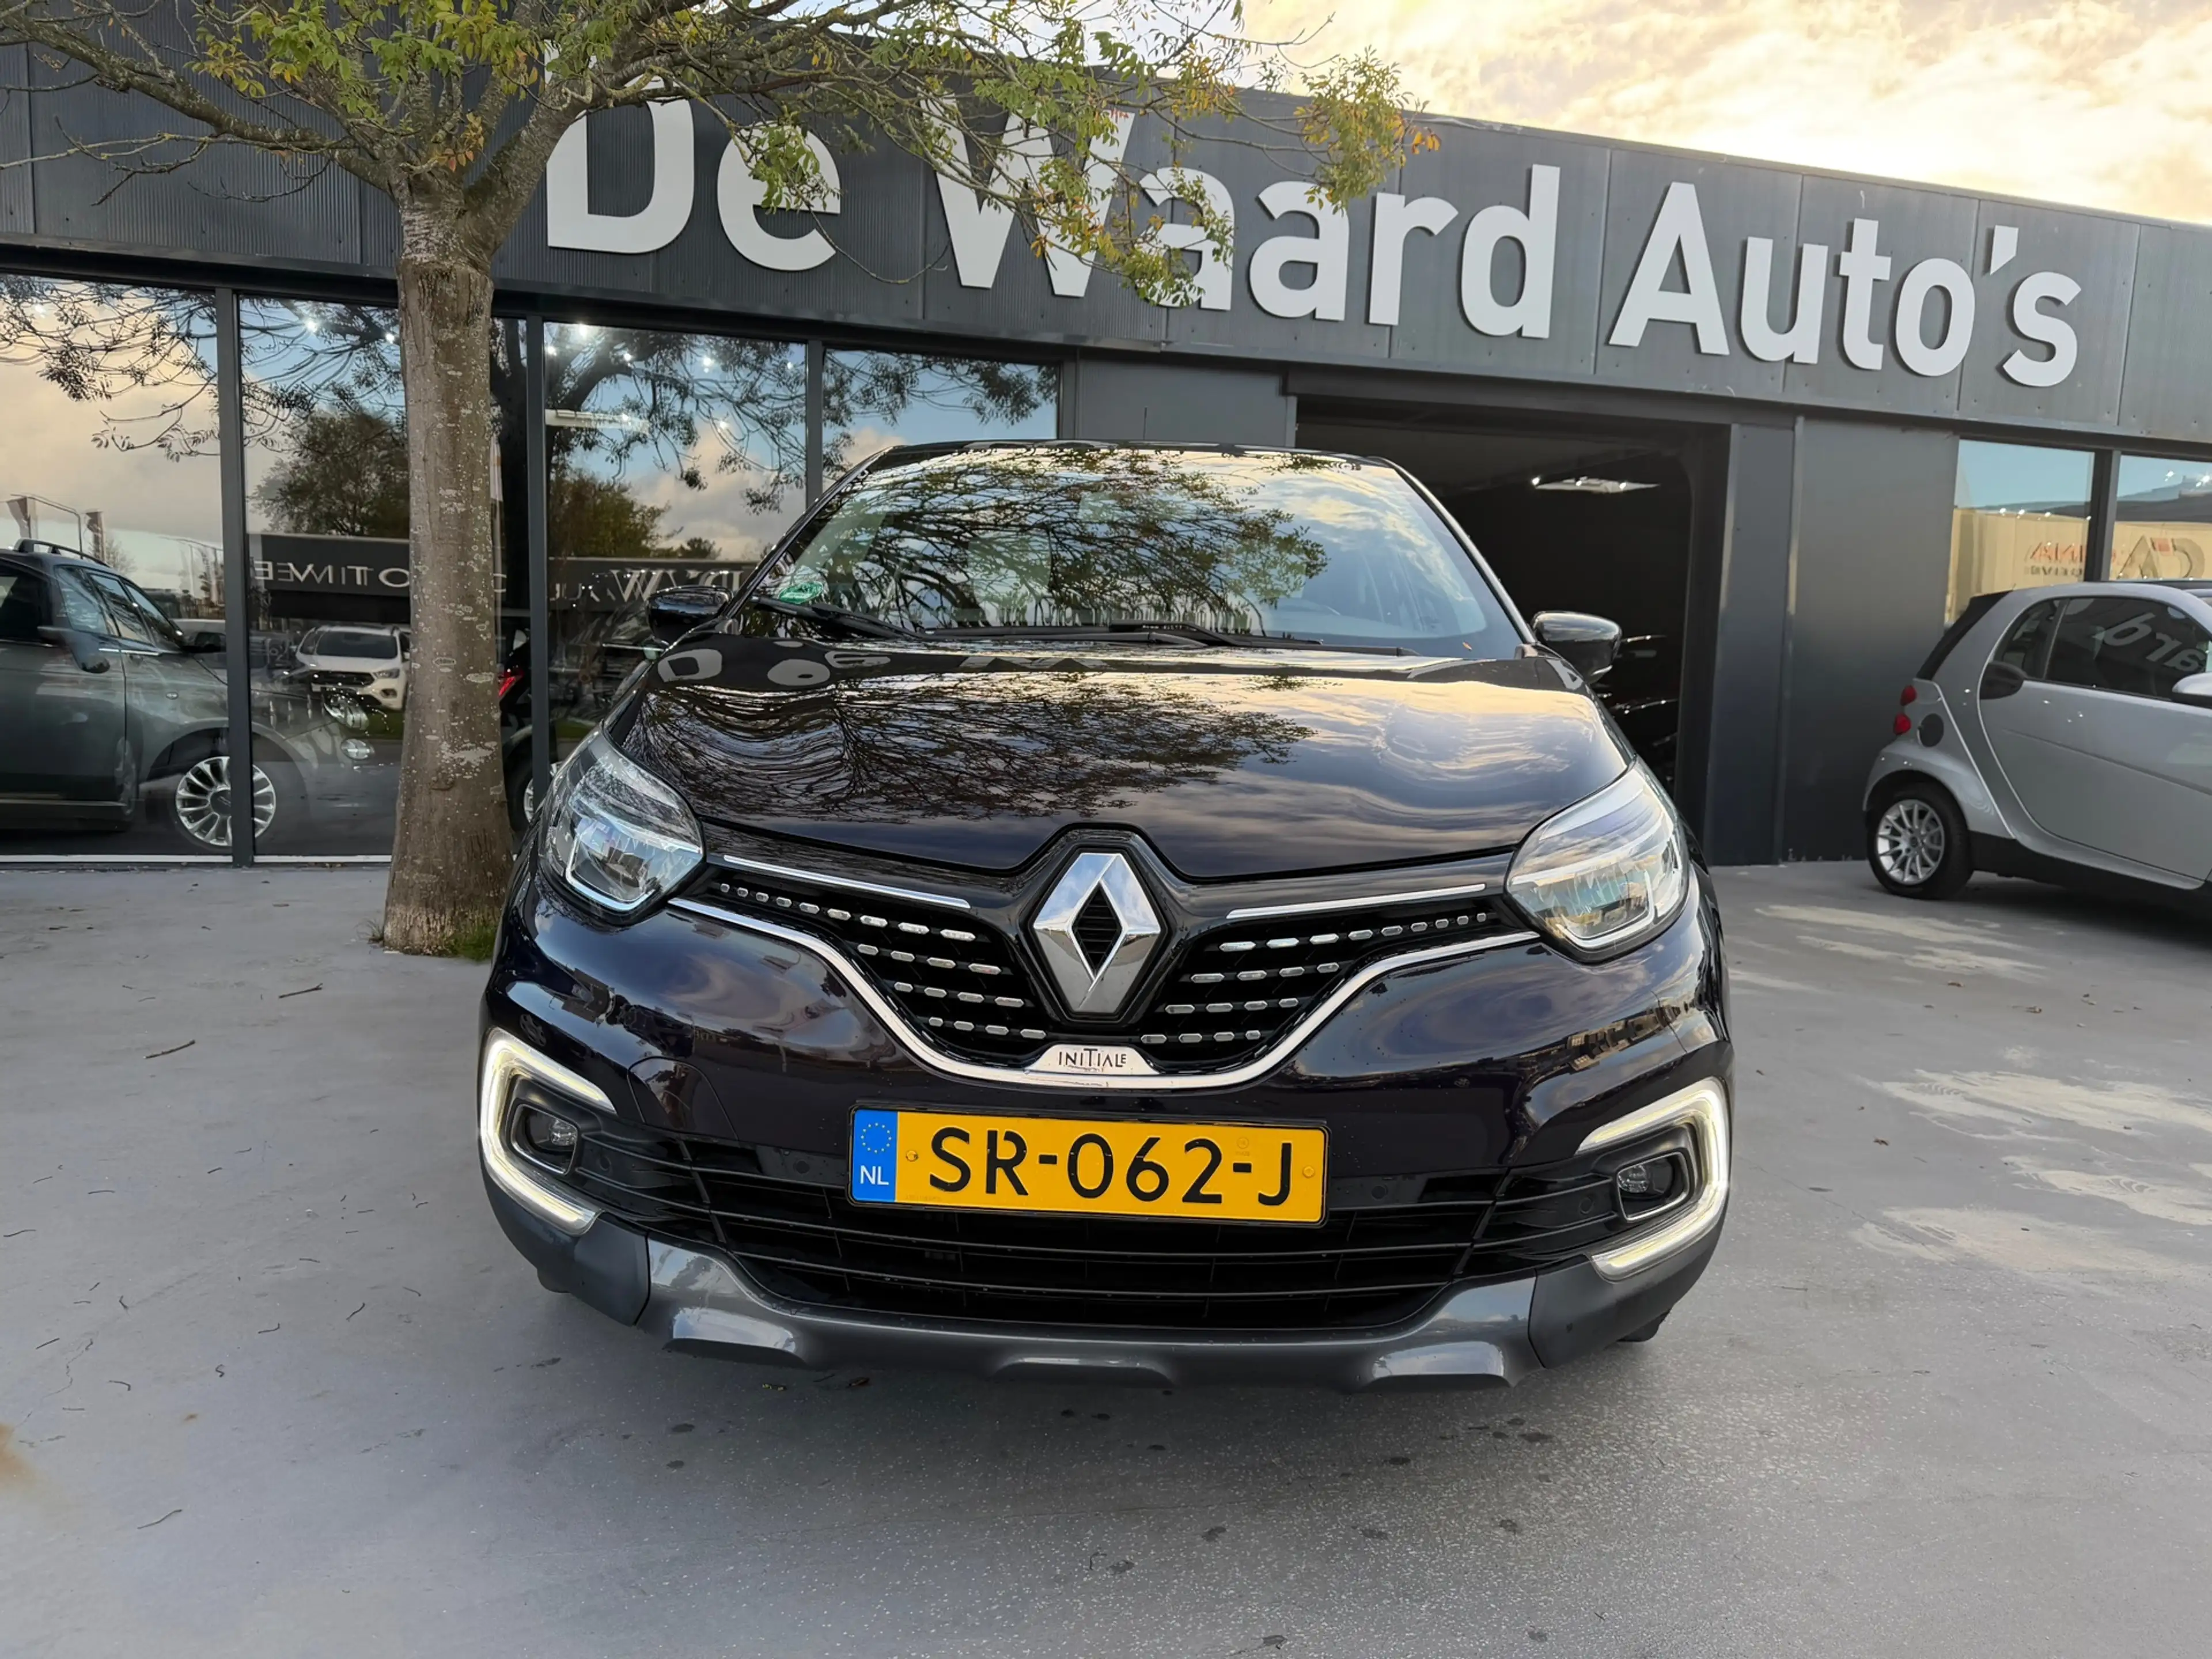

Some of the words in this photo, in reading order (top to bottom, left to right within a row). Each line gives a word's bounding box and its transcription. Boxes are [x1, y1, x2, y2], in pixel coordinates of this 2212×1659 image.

[544, 39, 840, 271] De
[920, 92, 1560, 339] Waard
[1608, 181, 2081, 387] Auto's
[1058, 1048, 1127, 1068] INITIALE
[859, 1164, 890, 1186] NL
[929, 1126, 1292, 1206] SR-062-J
